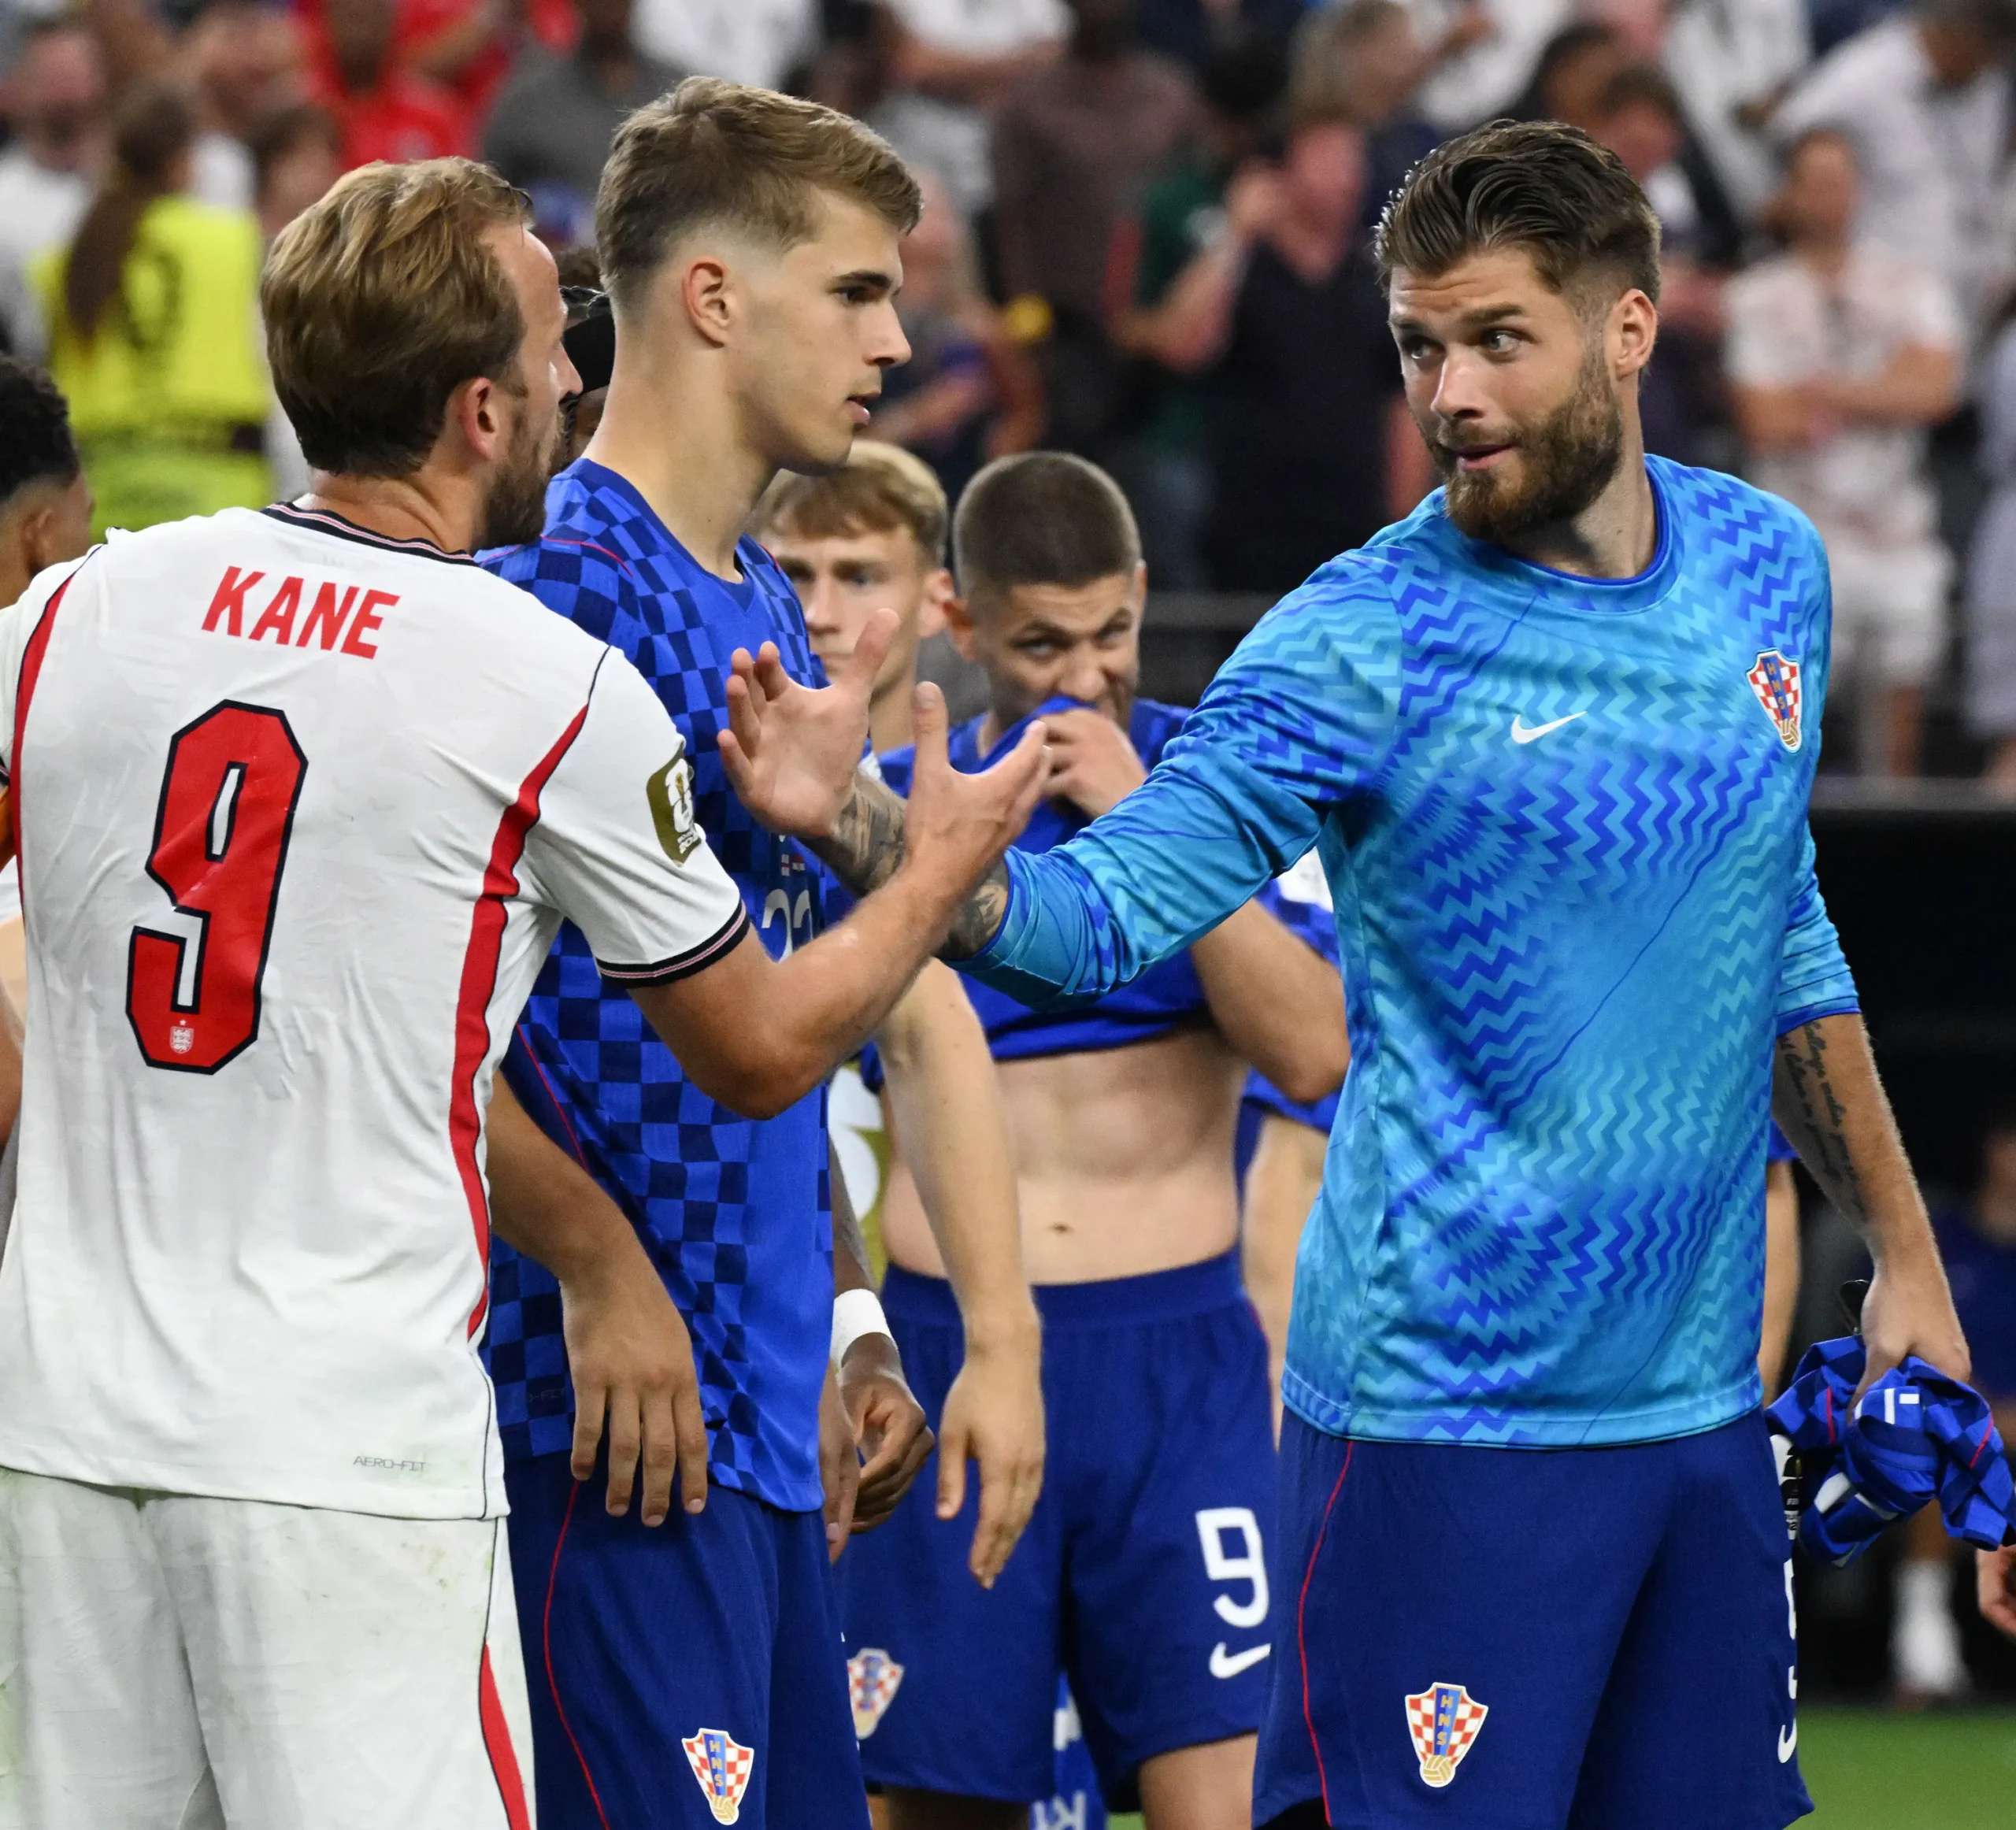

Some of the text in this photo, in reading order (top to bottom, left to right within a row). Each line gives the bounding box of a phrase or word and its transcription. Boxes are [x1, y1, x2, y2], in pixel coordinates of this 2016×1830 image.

[202, 565, 401, 660] KANE
[126, 698, 309, 1076] 9
[353, 1455, 426, 1473] AERO-FIT
[1195, 1506, 1269, 1628] 9
[1436, 1694, 1455, 1746] HNS
[710, 1739, 724, 1787] HNS
